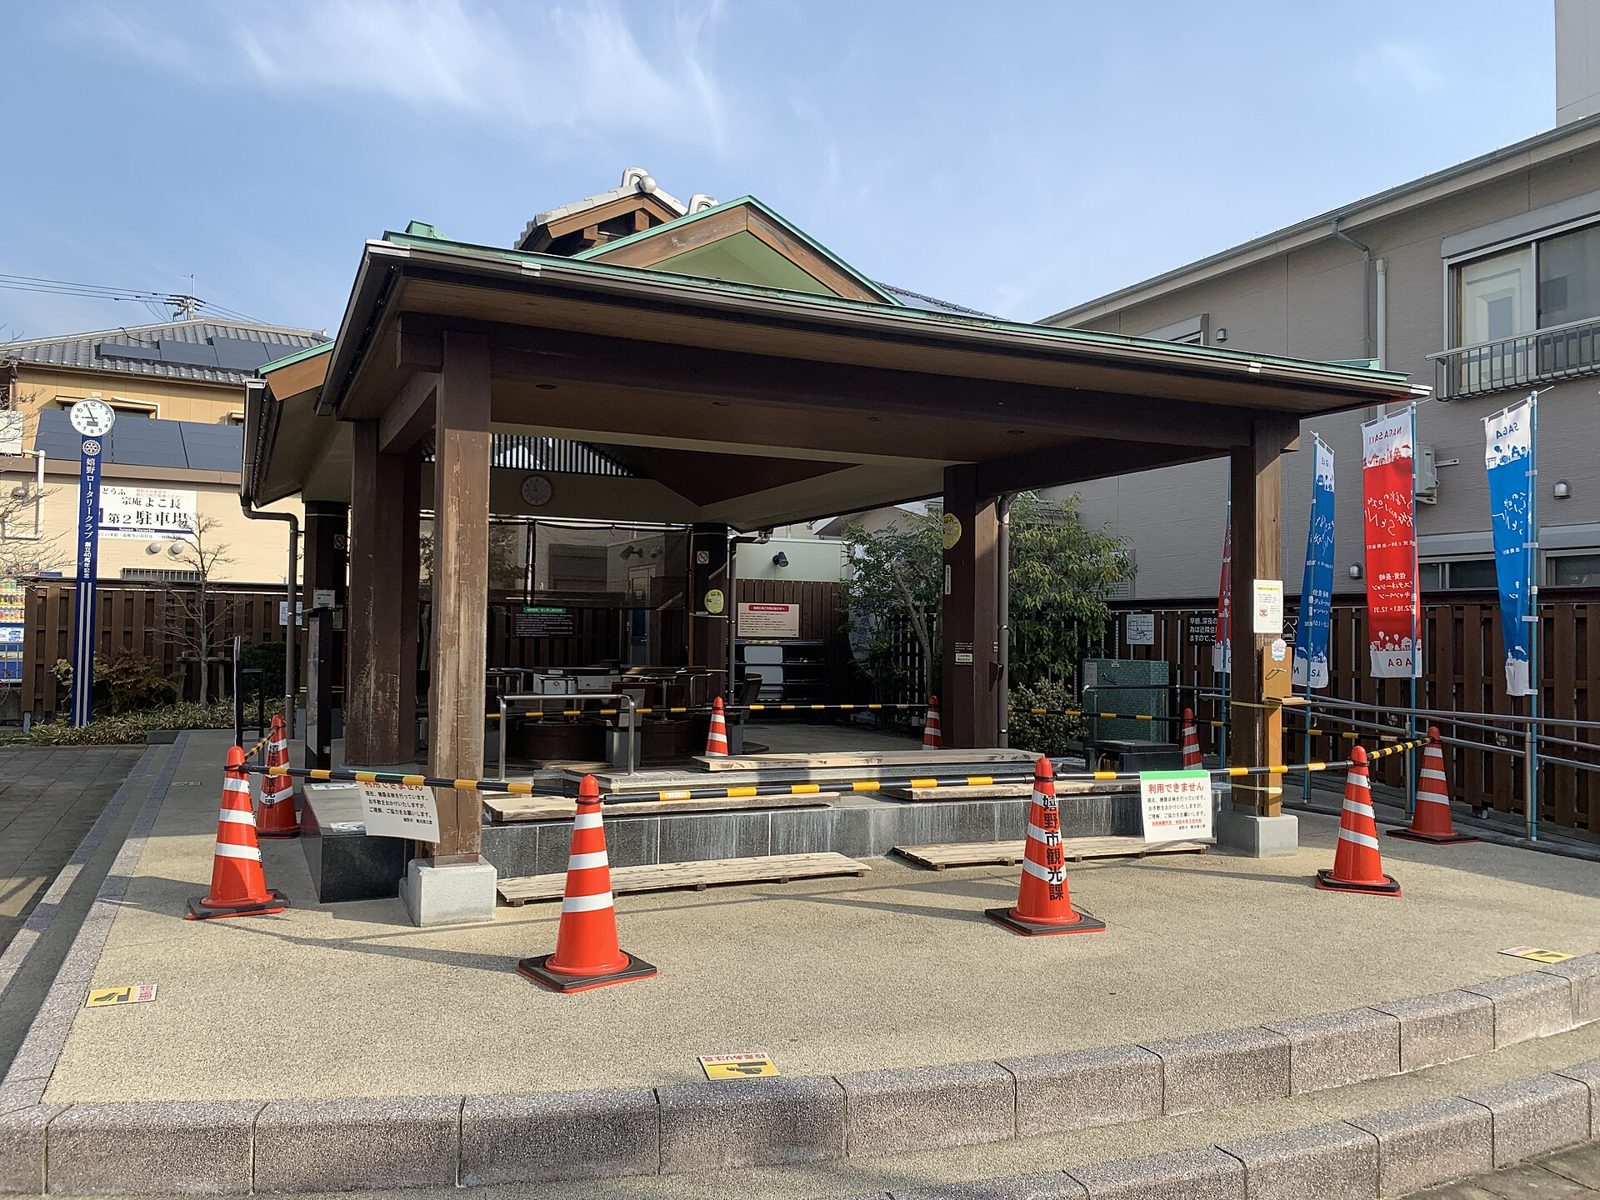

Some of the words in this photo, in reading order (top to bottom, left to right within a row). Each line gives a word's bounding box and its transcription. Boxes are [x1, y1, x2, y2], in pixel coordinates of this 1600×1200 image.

[84, 457, 96, 539] 嬉野ロータリークラブ
[1189, 626, 1218, 634] 為は近隣住
[1148, 782, 1204, 794] 利用できません
[1042, 795, 1064, 900] 嬉野市観光課
